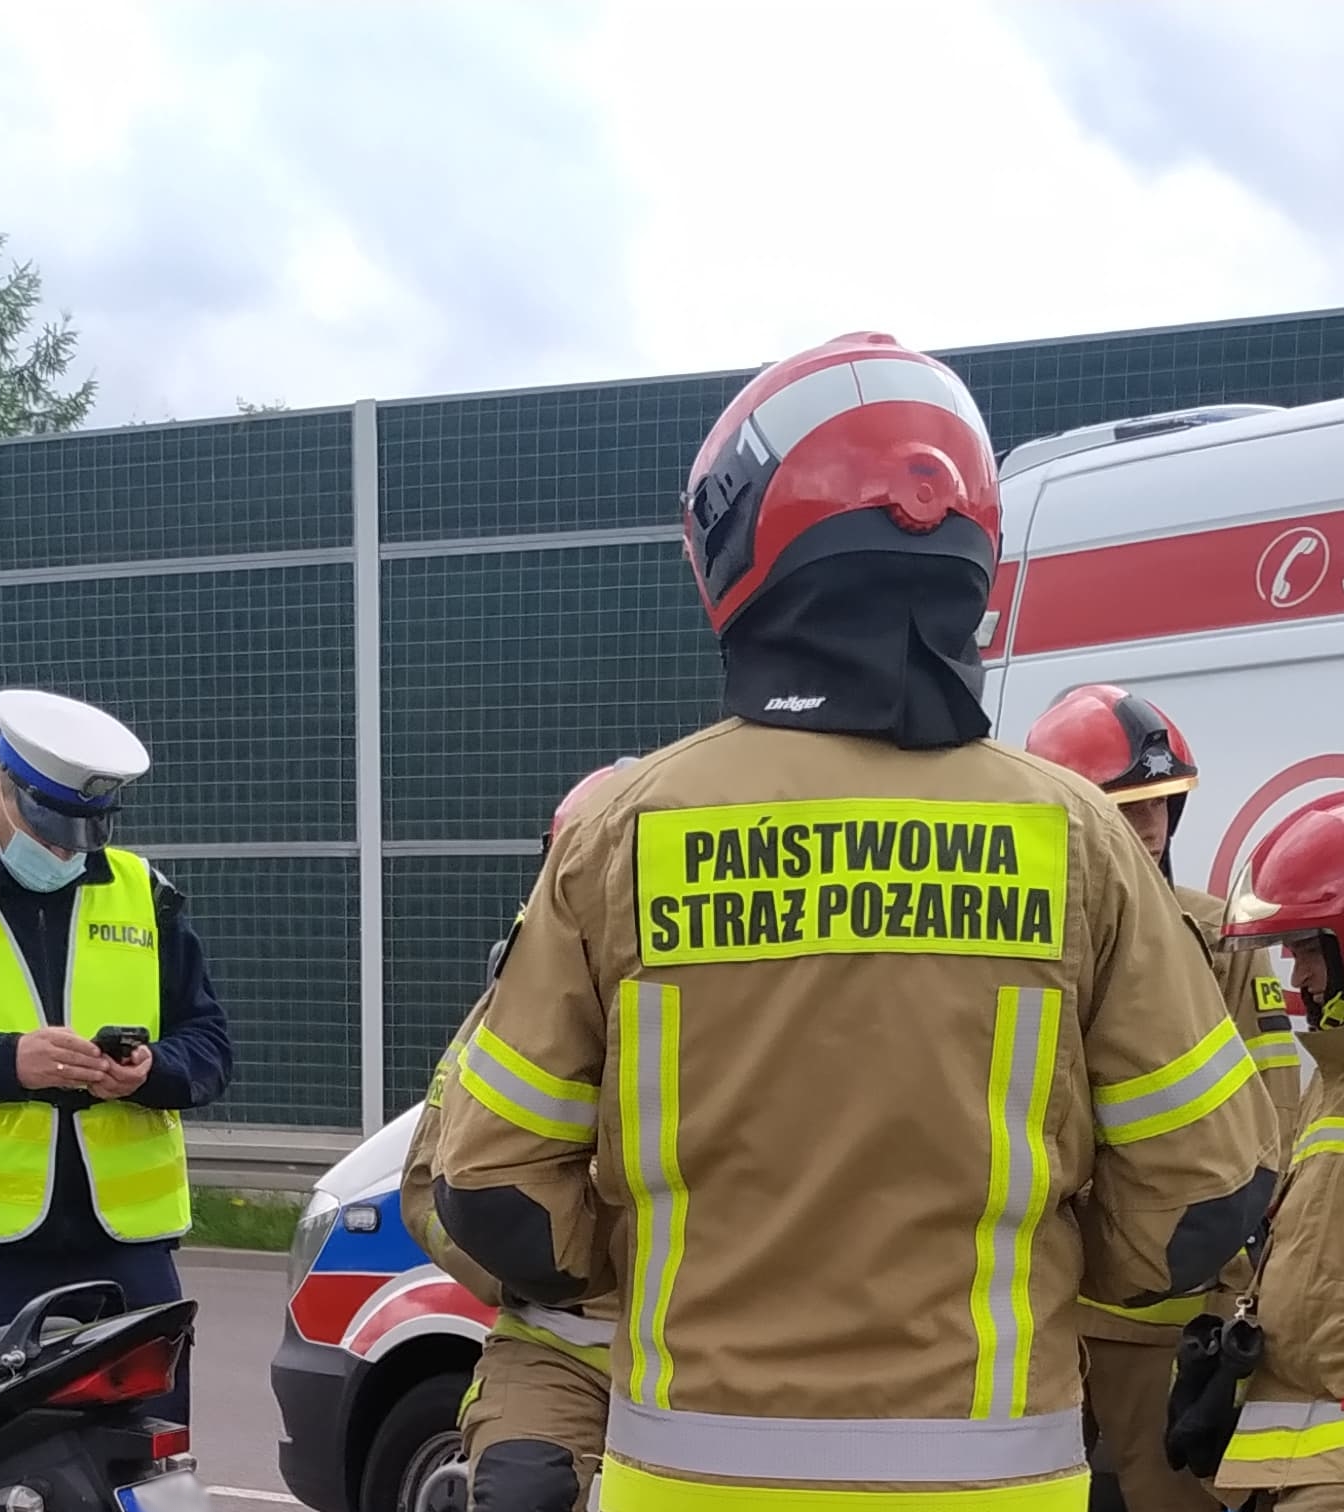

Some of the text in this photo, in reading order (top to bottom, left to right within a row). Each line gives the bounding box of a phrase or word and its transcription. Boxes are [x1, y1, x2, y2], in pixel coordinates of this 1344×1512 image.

[685, 816, 1019, 883] PAŃSTWOWA
[88, 923, 154, 951] POLICJA
[650, 881, 1052, 952] STRAŻ POŻARNA
[1260, 980, 1282, 1005] PS
